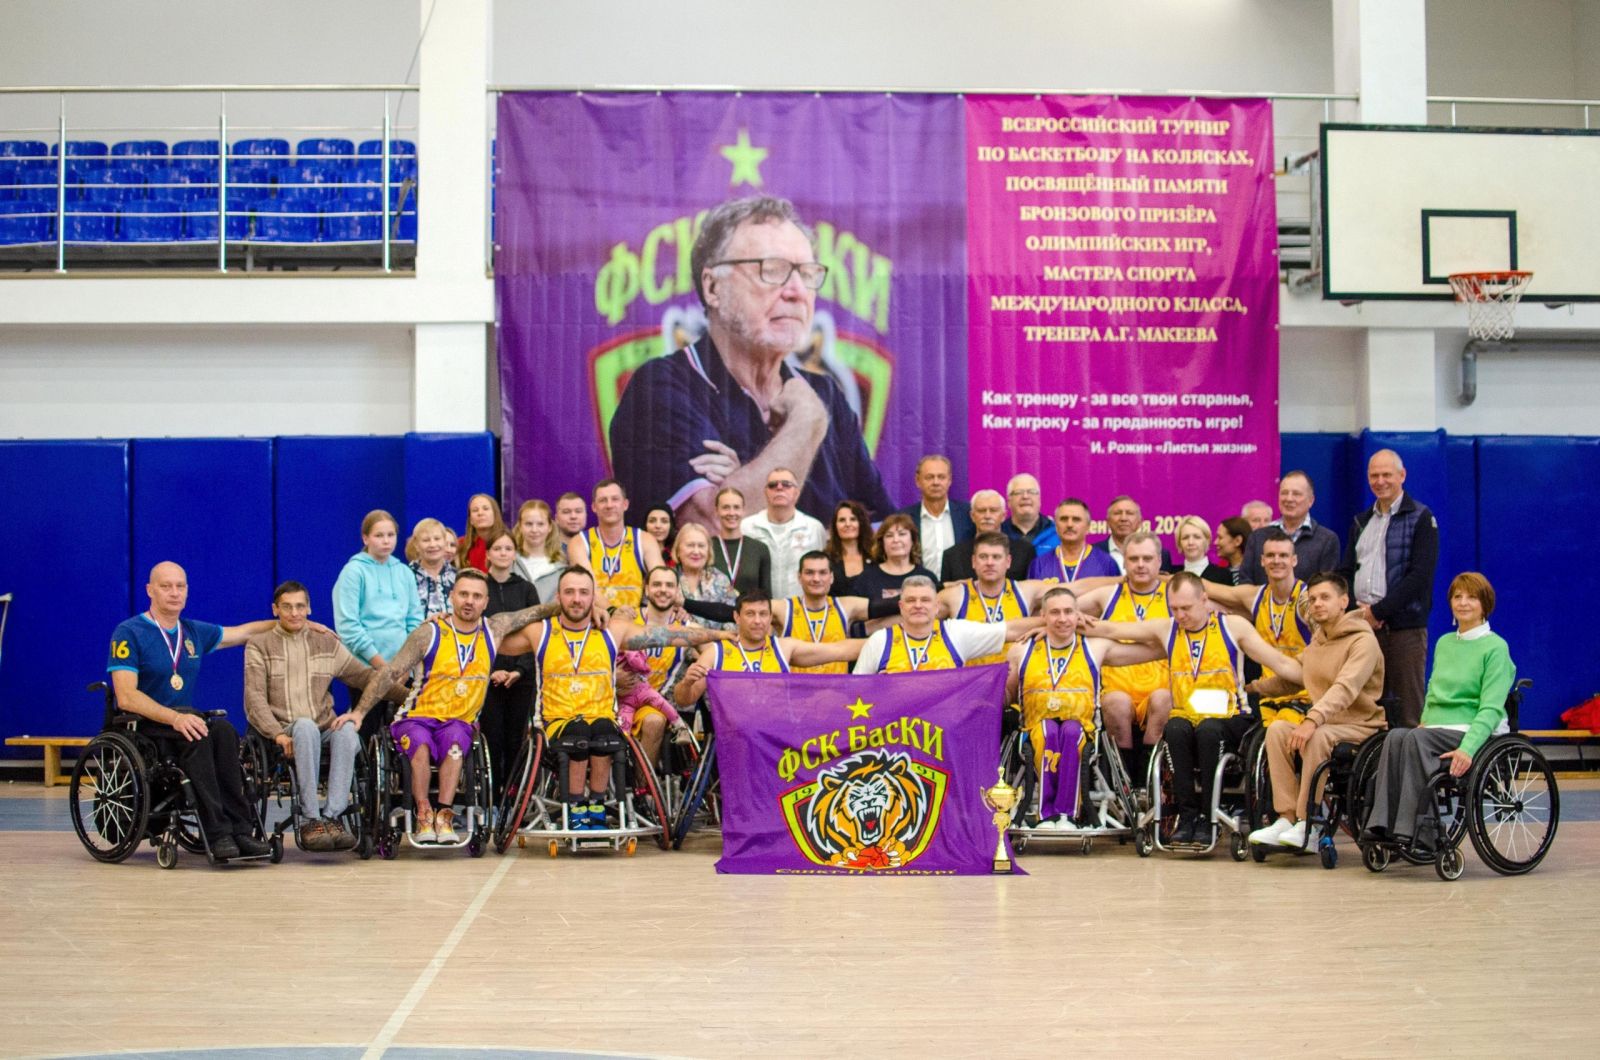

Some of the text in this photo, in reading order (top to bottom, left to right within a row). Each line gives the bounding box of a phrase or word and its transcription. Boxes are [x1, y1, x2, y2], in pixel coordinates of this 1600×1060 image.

[1002, 115, 1231, 136] ВСЕРОССИЙСКИЙ ТУРНИР
[978, 146, 1255, 167] ПО БАСКЕТБОЛУ НА КОЛЯСКАХ,
[1006, 173, 1228, 195] ПОСВЯЩЁННЫЙ ПАМЯТИ
[1020, 205, 1217, 222] БРОНЗОВОГО ПРИЗЁРА
[1025, 234, 1212, 255] ОЛИМПИЙСКИХ ИГР,
[1044, 266, 1196, 282] МАСТЕРА СПОРТА
[991, 295, 1248, 314] МЕЖДУНАРОДНОГО КЛАССА,
[1023, 326, 1218, 342] ТРЕНЕРА А.Г. МАКЕЕВА
[982, 390, 1013, 405] Как
[1015, 393, 1079, 409] тренеру
[1090, 393, 1109, 406] за
[1110, 393, 1139, 406] все
[1140, 393, 1178, 406] твои
[1180, 393, 1254, 409] старанья,
[982, 413, 1013, 429] Как
[1015, 416, 1070, 432] игроку
[1082, 416, 1100, 429] за
[1102, 416, 1202, 432] преданность
[1205, 415, 1244, 432] игре!
[1090, 440, 1258, 454] И. Рожин «Листья жизни»
[111, 640, 131, 659] 16
[1191, 640, 1201, 658] 5
[777, 730, 842, 783] ФСК
[915, 765, 937, 780] 91
[792, 786, 812, 801] 19
